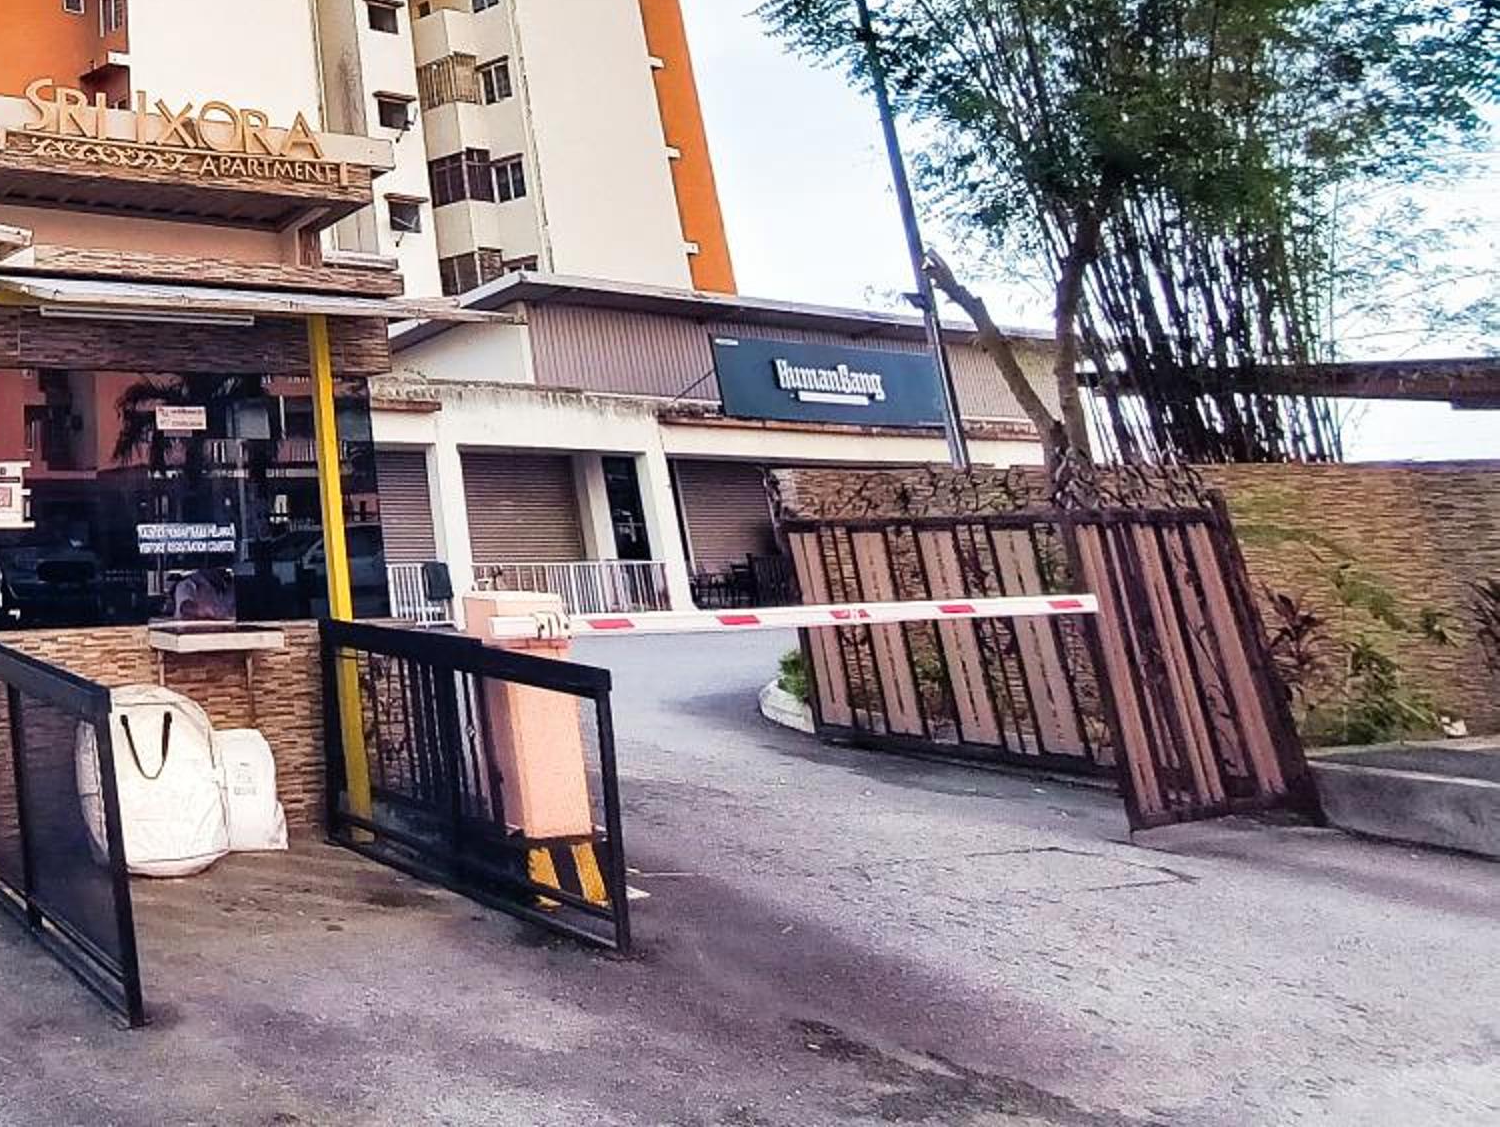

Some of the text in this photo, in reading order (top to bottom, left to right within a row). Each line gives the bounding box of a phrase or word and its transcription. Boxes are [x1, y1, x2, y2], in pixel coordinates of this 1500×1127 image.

[24, 78, 326, 160] SRI IXORA
[200, 154, 339, 183] APARTMENT
